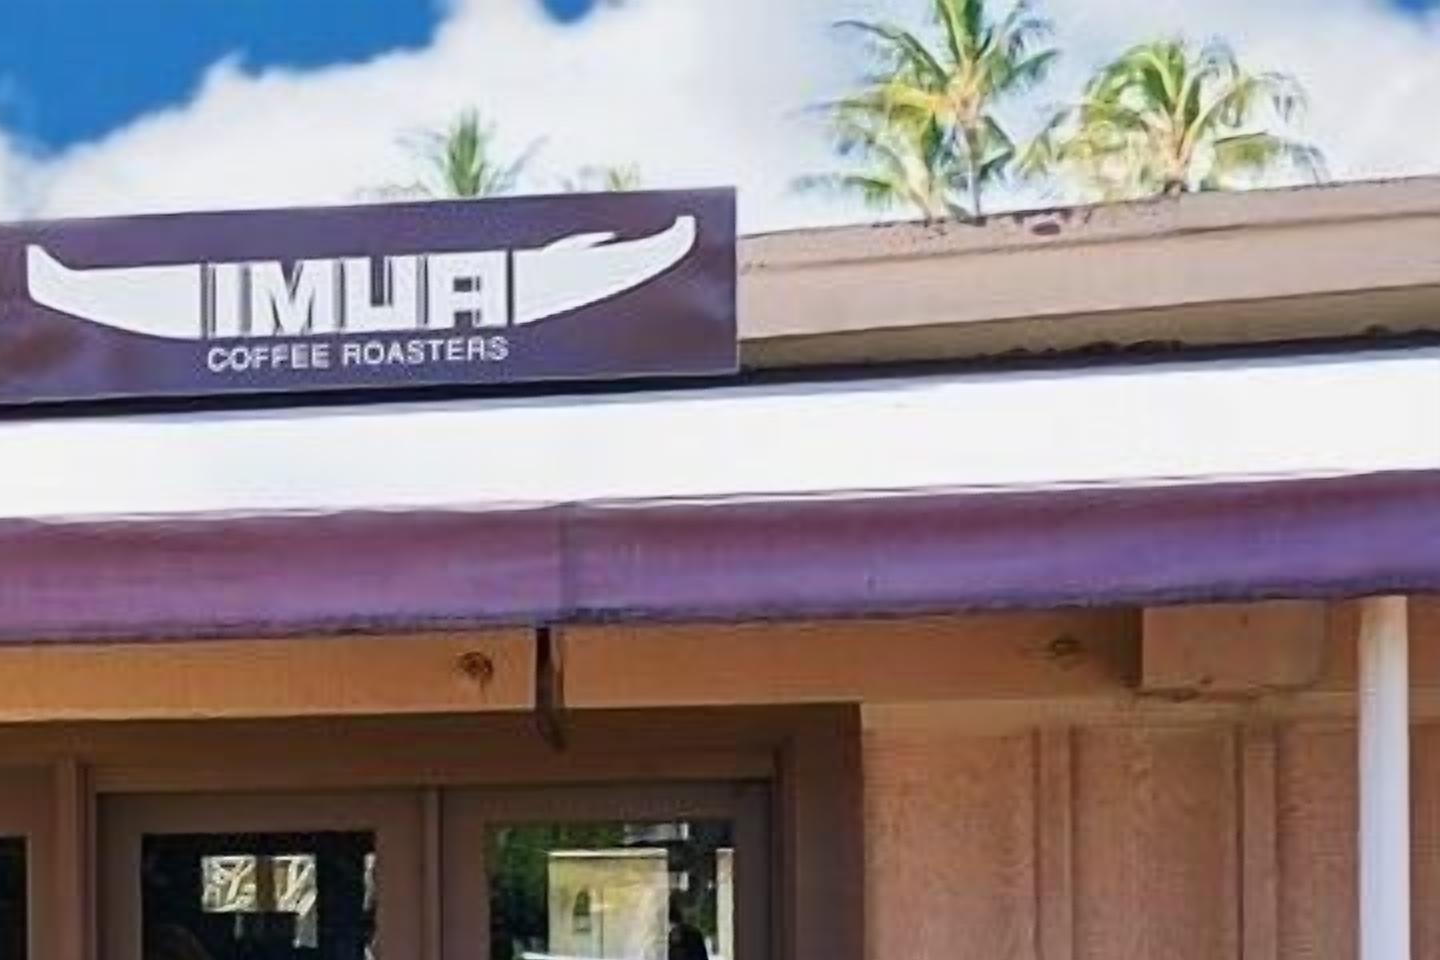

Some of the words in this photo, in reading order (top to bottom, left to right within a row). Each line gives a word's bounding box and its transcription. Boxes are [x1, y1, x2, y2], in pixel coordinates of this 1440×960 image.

[208, 250, 508, 338] IMUA
[207, 343, 330, 372] COFFEE
[341, 335, 509, 367] ROASTERS
